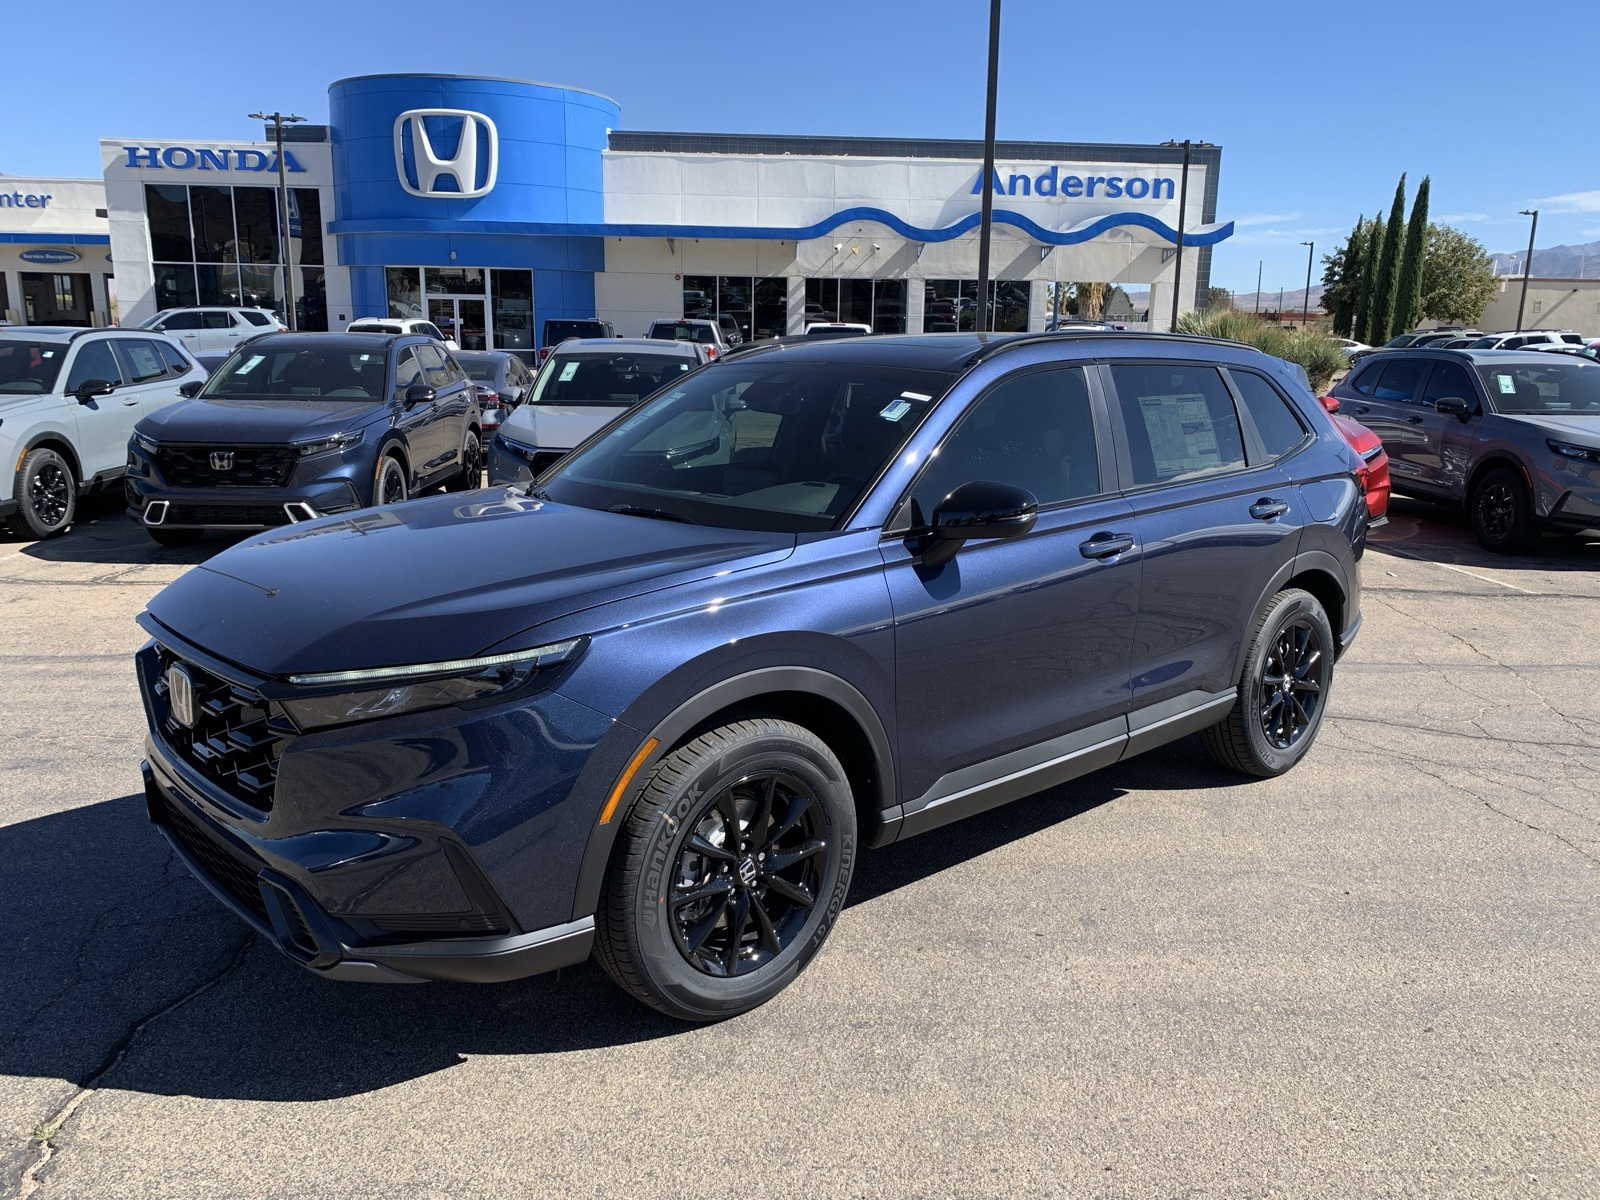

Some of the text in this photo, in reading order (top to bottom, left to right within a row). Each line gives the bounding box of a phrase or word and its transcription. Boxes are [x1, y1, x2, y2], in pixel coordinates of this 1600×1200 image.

[123, 146, 306, 173] HONDA
[970, 165, 1175, 200] Anderson
[446, 277, 496, 286] WELCOE
